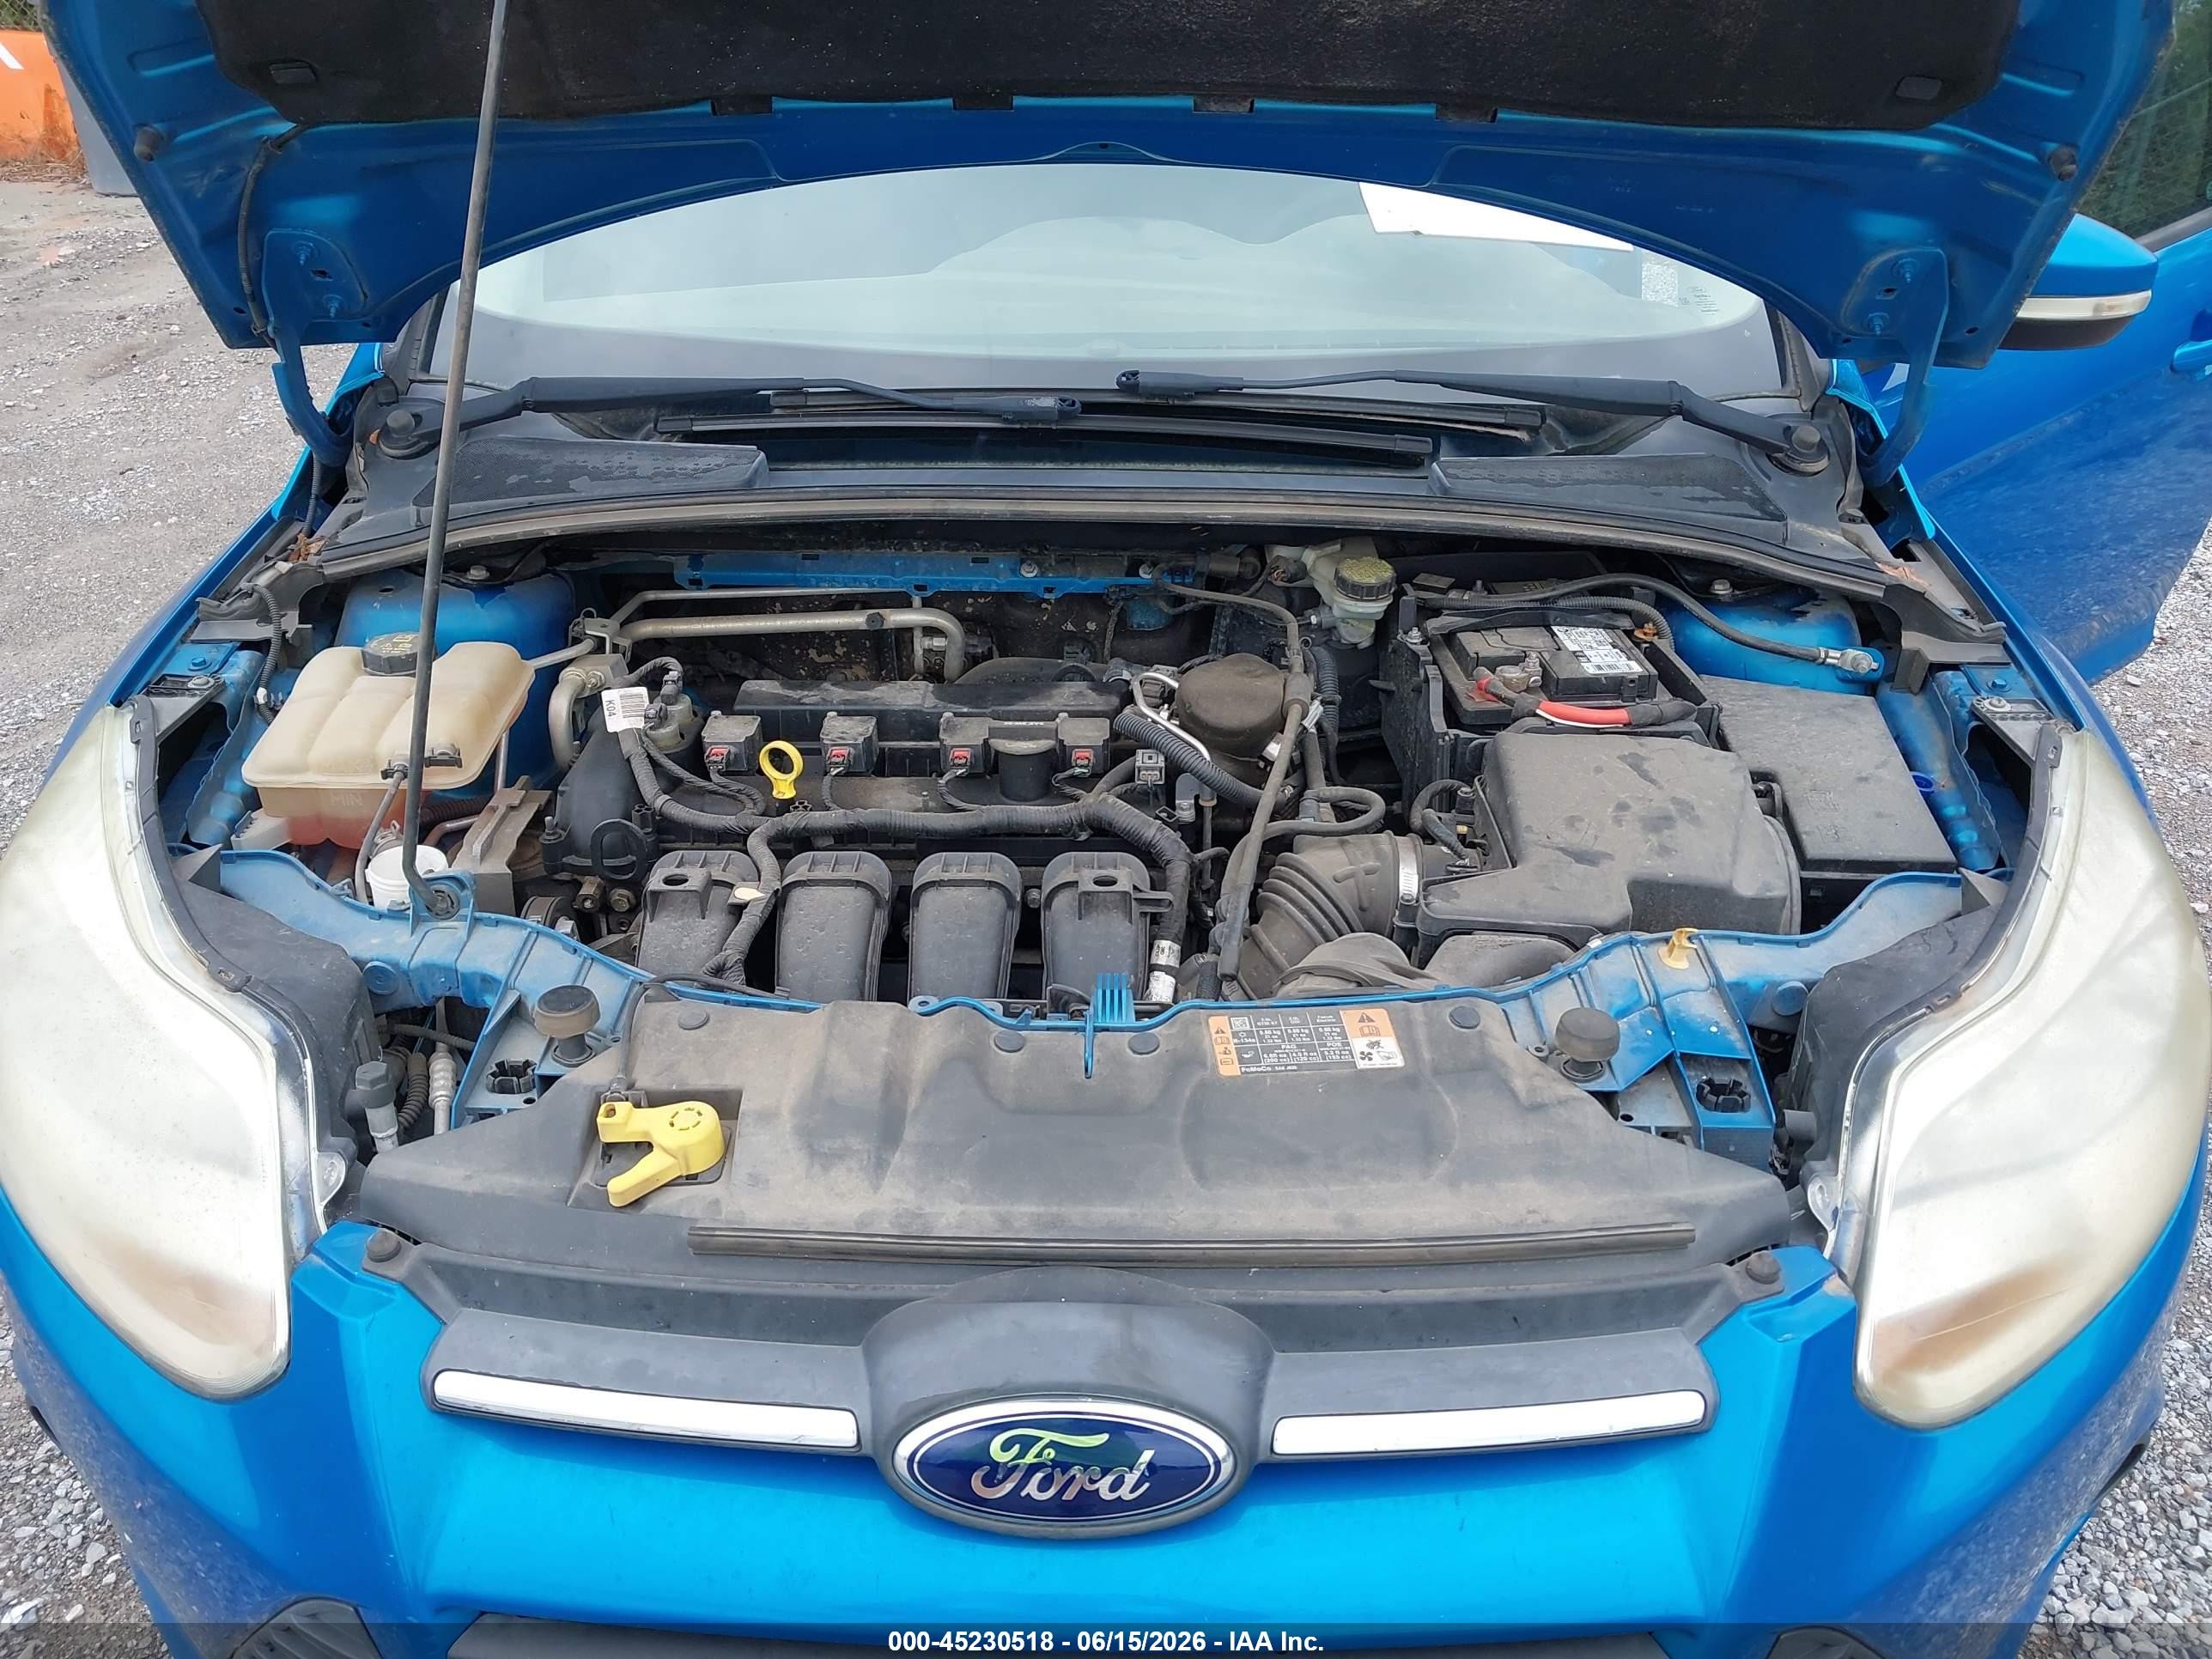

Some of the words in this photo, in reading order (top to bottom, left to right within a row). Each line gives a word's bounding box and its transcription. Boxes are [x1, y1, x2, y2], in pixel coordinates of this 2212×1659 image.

[605, 700, 617, 717] K04
[329, 792, 363, 808] MIN
[971, 1427, 1155, 1501] Ford
